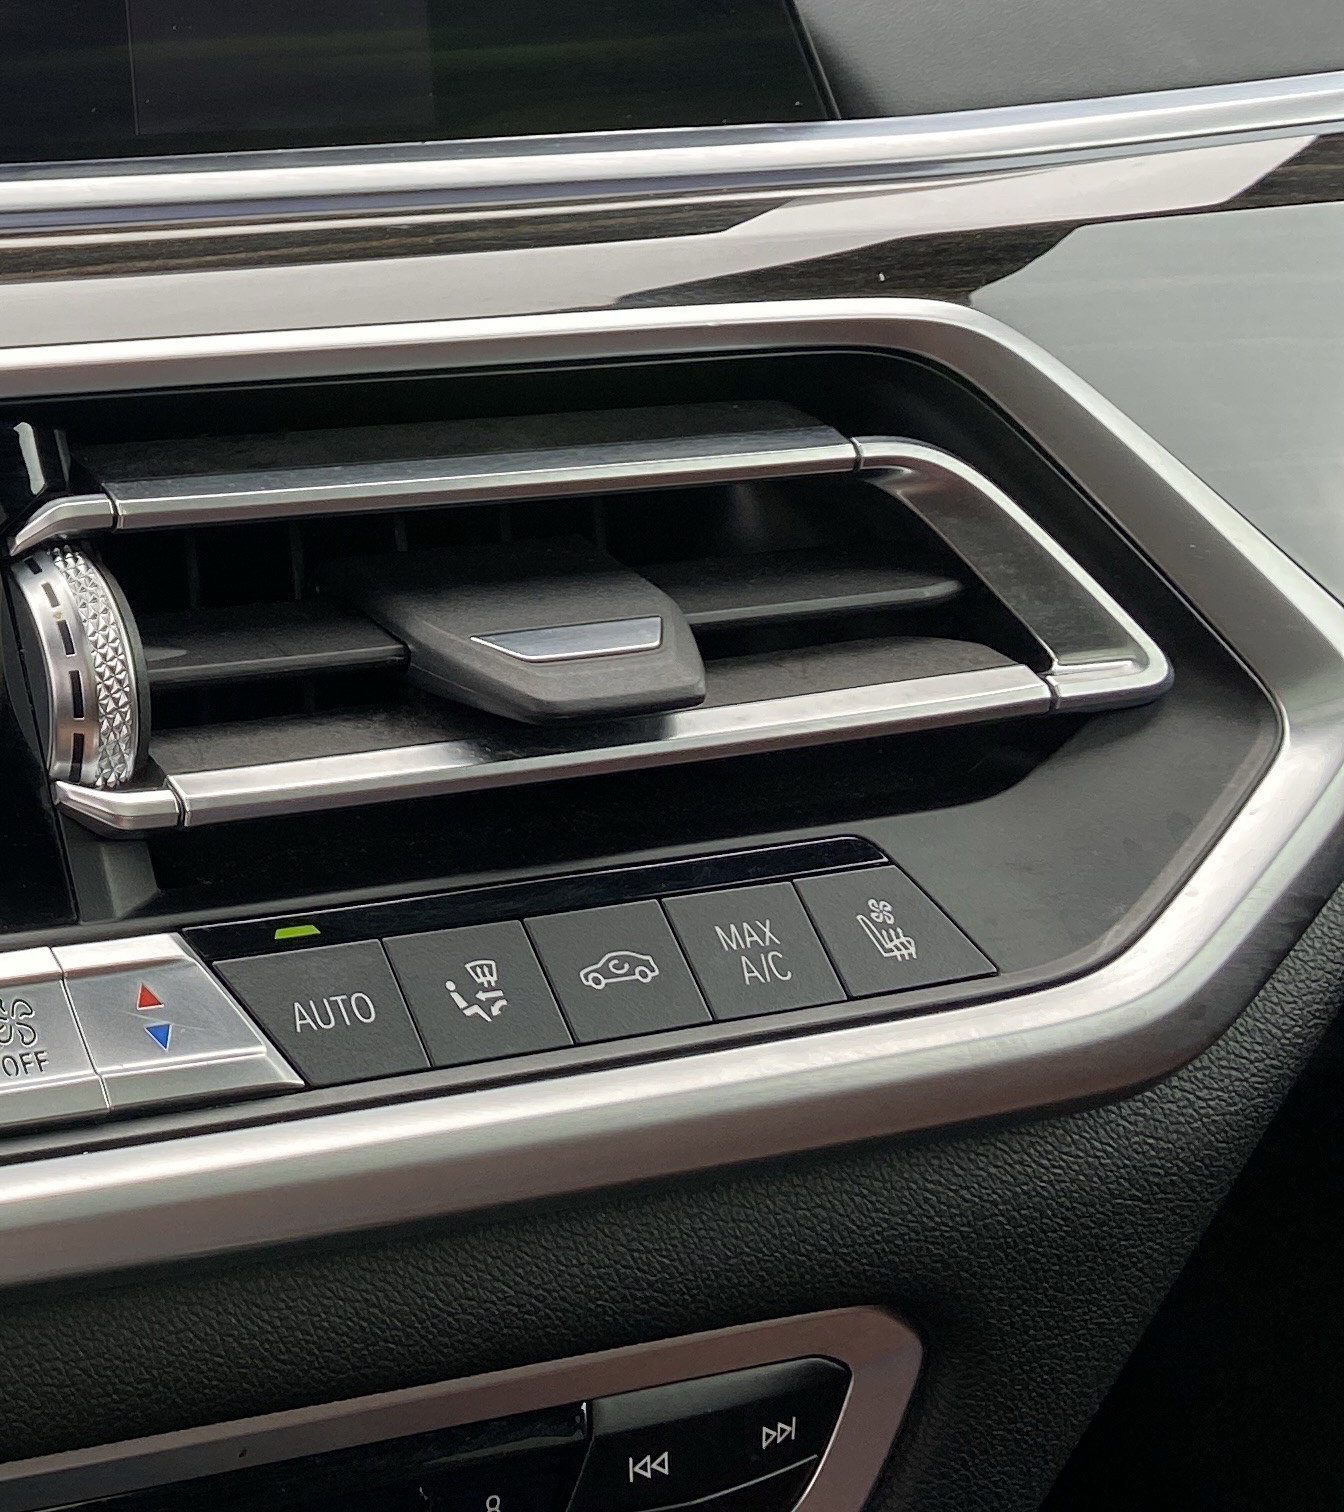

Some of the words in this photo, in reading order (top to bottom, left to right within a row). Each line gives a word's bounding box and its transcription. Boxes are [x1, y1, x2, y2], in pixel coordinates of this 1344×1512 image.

[714, 919, 781, 952] MAX
[740, 951, 792, 986] A/C
[293, 992, 376, 1034] AUTO
[1, 1049, 48, 1078] OFF
